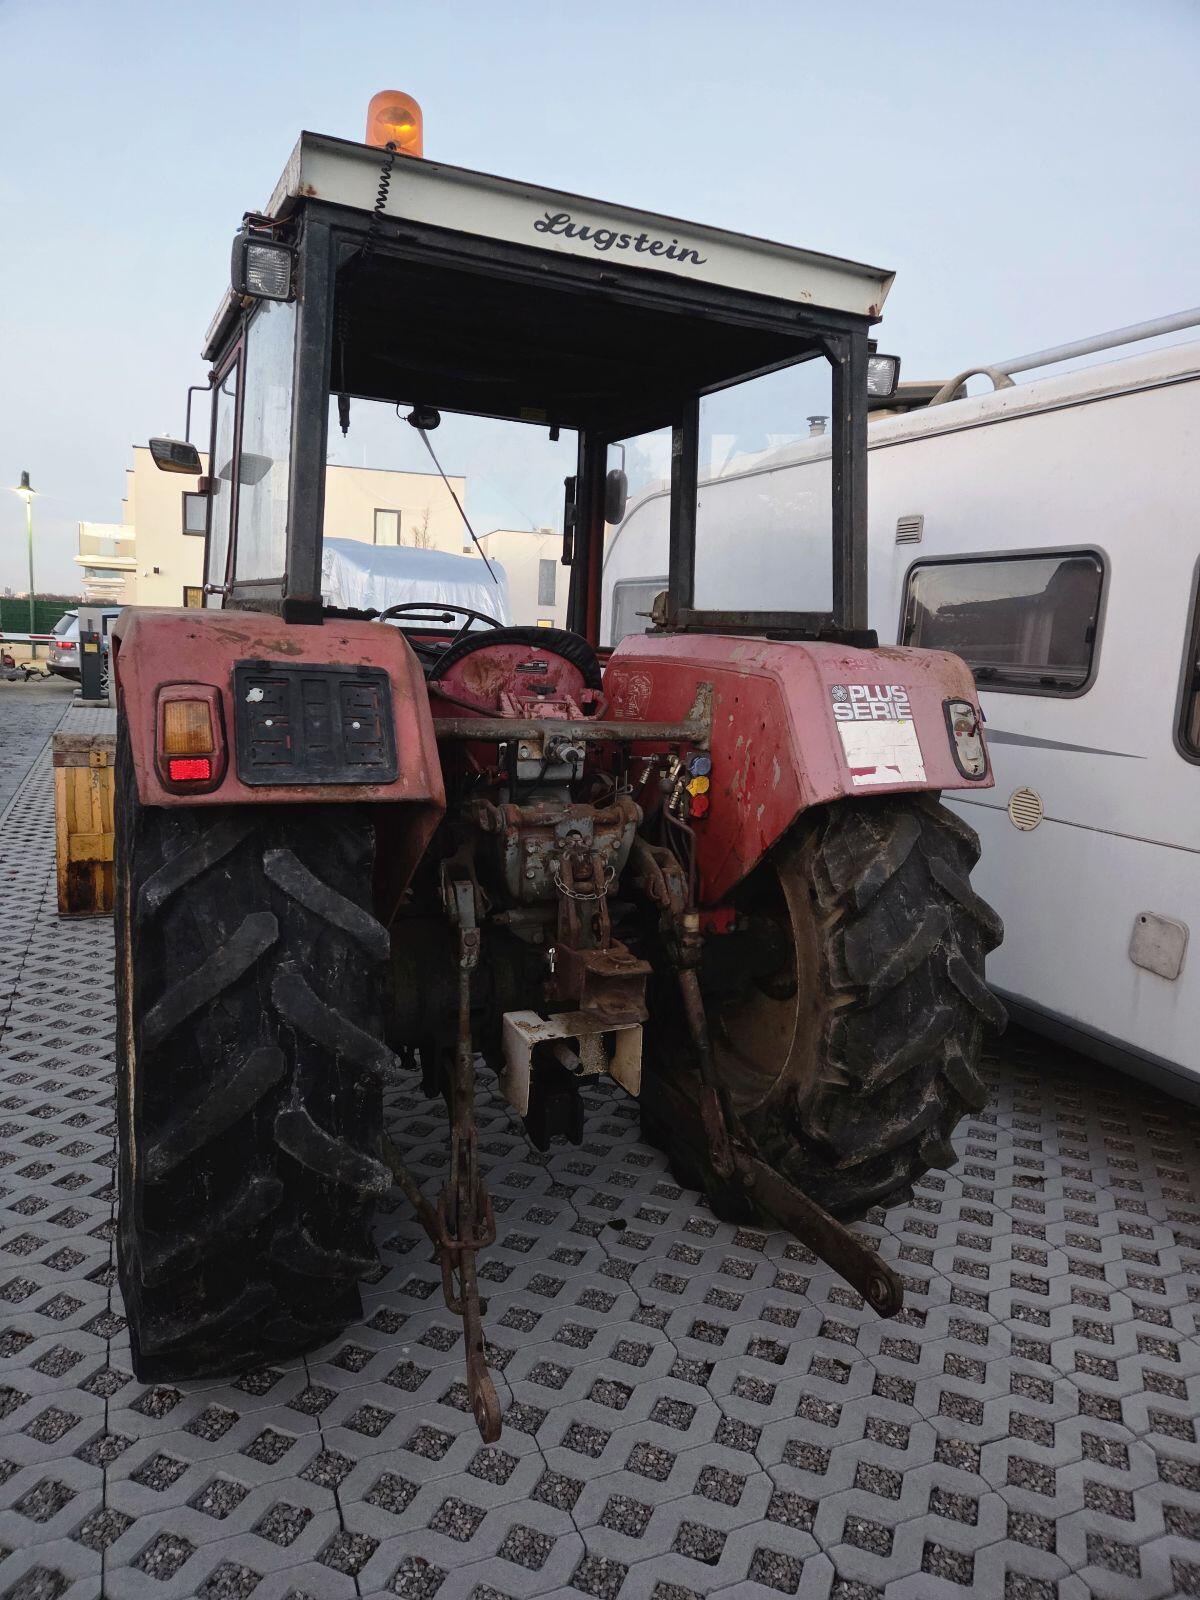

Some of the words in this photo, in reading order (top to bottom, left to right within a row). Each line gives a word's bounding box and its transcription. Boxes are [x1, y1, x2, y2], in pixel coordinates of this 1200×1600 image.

[533, 212, 707, 265] Lugstein
[848, 685, 908, 702] PLUS
[832, 702, 913, 720] SERIE
